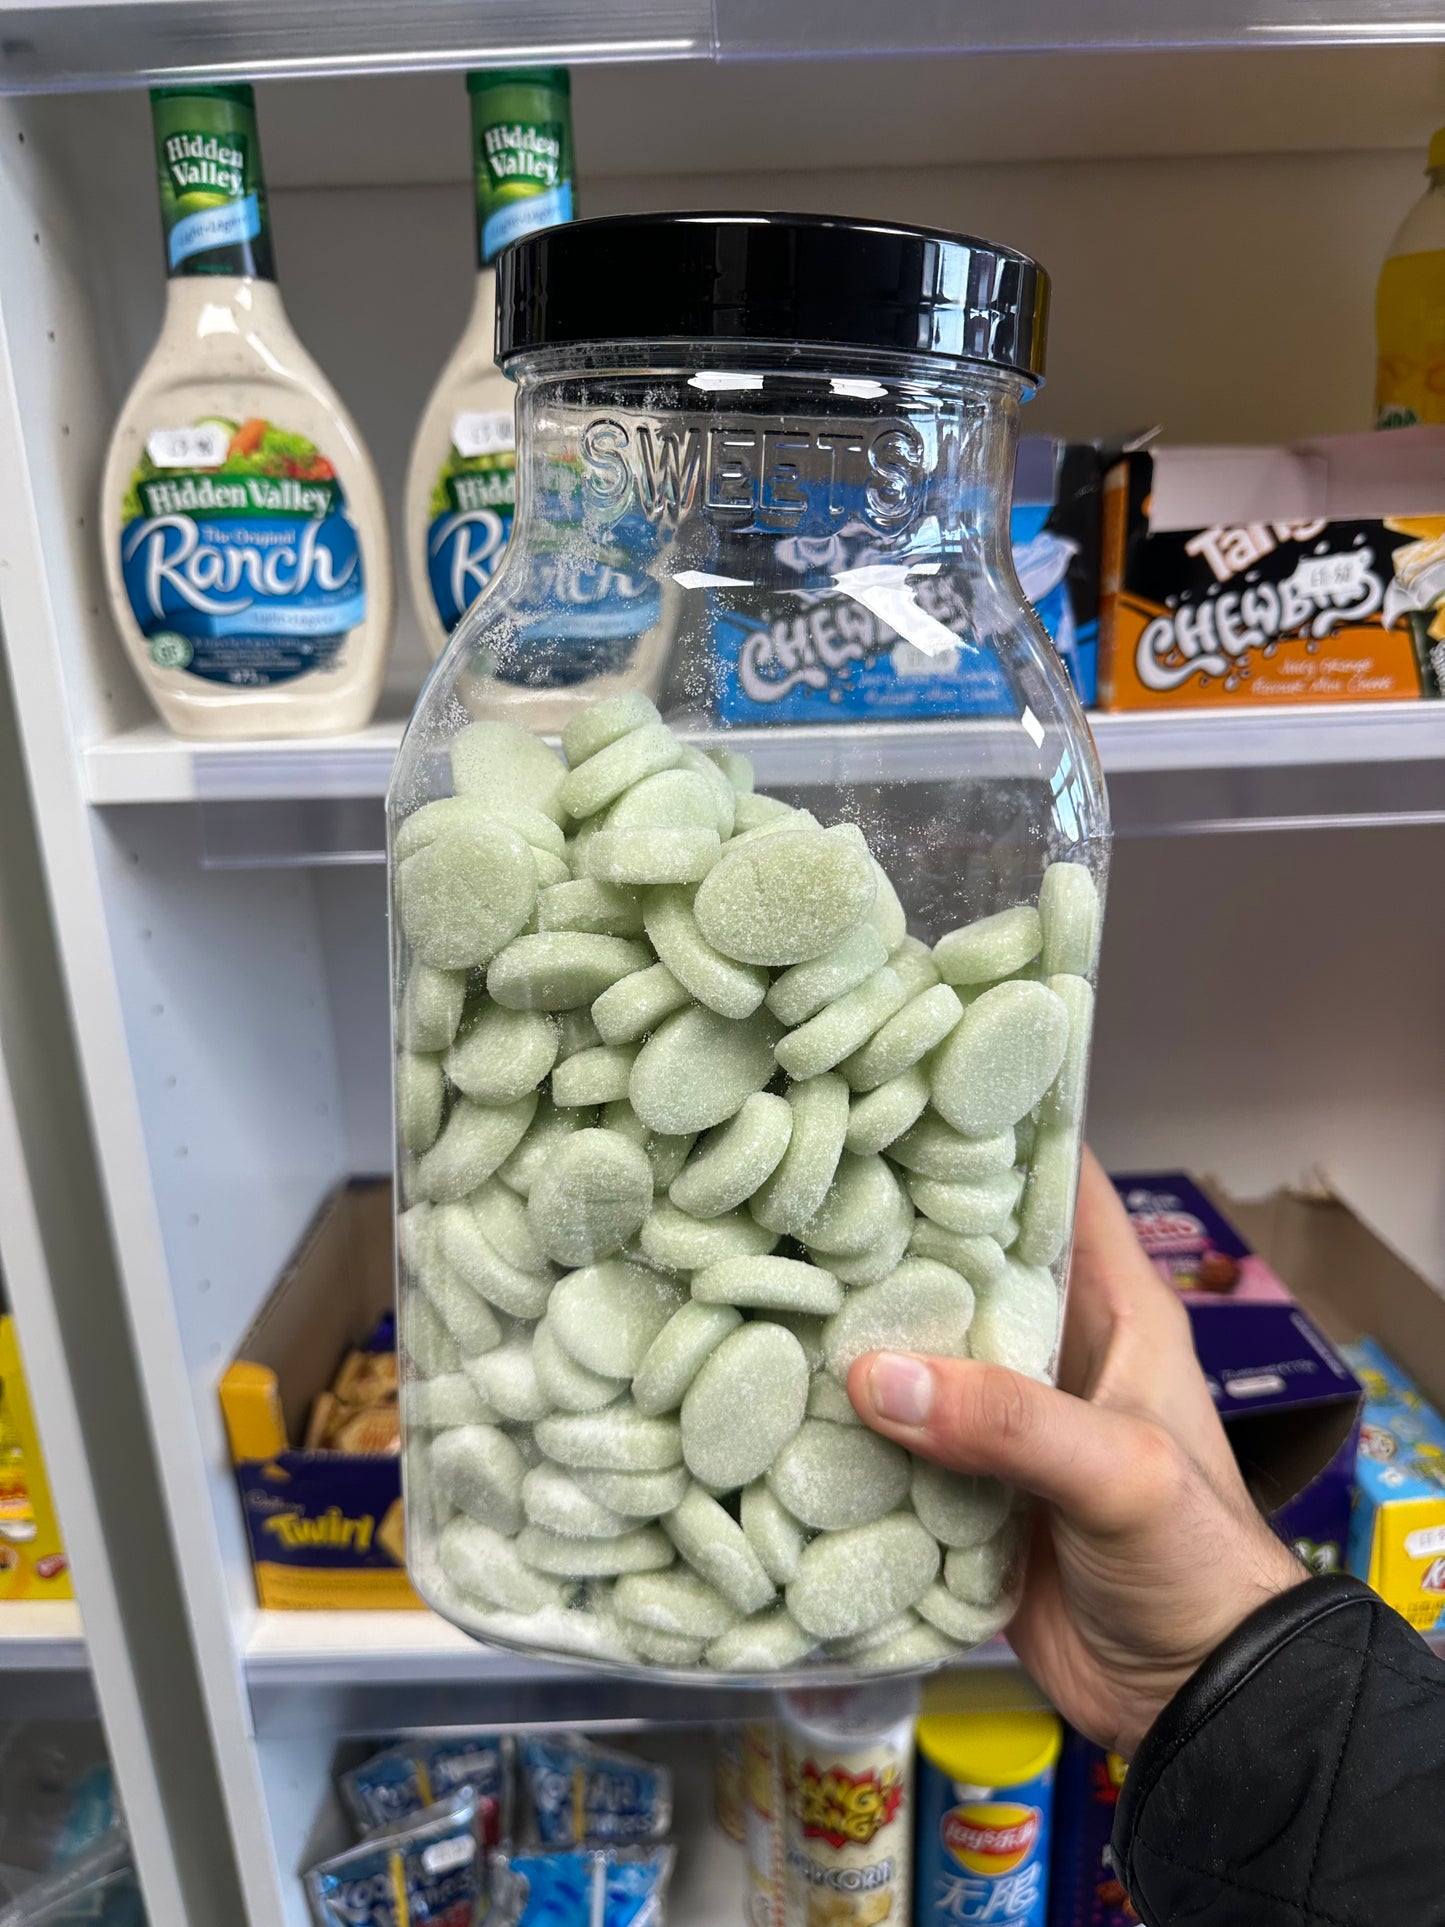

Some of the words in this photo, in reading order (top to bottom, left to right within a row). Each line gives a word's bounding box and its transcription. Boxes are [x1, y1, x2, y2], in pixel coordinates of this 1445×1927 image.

[166, 133, 244, 169] Hidden
[485, 123, 559, 158] Hidden
[171, 160, 243, 195] Valley
[490, 150, 558, 185] Valley
[453, 477, 516, 510] Hidd
[580, 416, 926, 534] SWEETS
[147, 478, 248, 516] Hidden
[250, 479, 332, 519] Valley
[125, 513, 360, 621] Ranch
[262, 1505, 375, 1553] Twirl
[934, 1860, 1042, 1921] 无限
